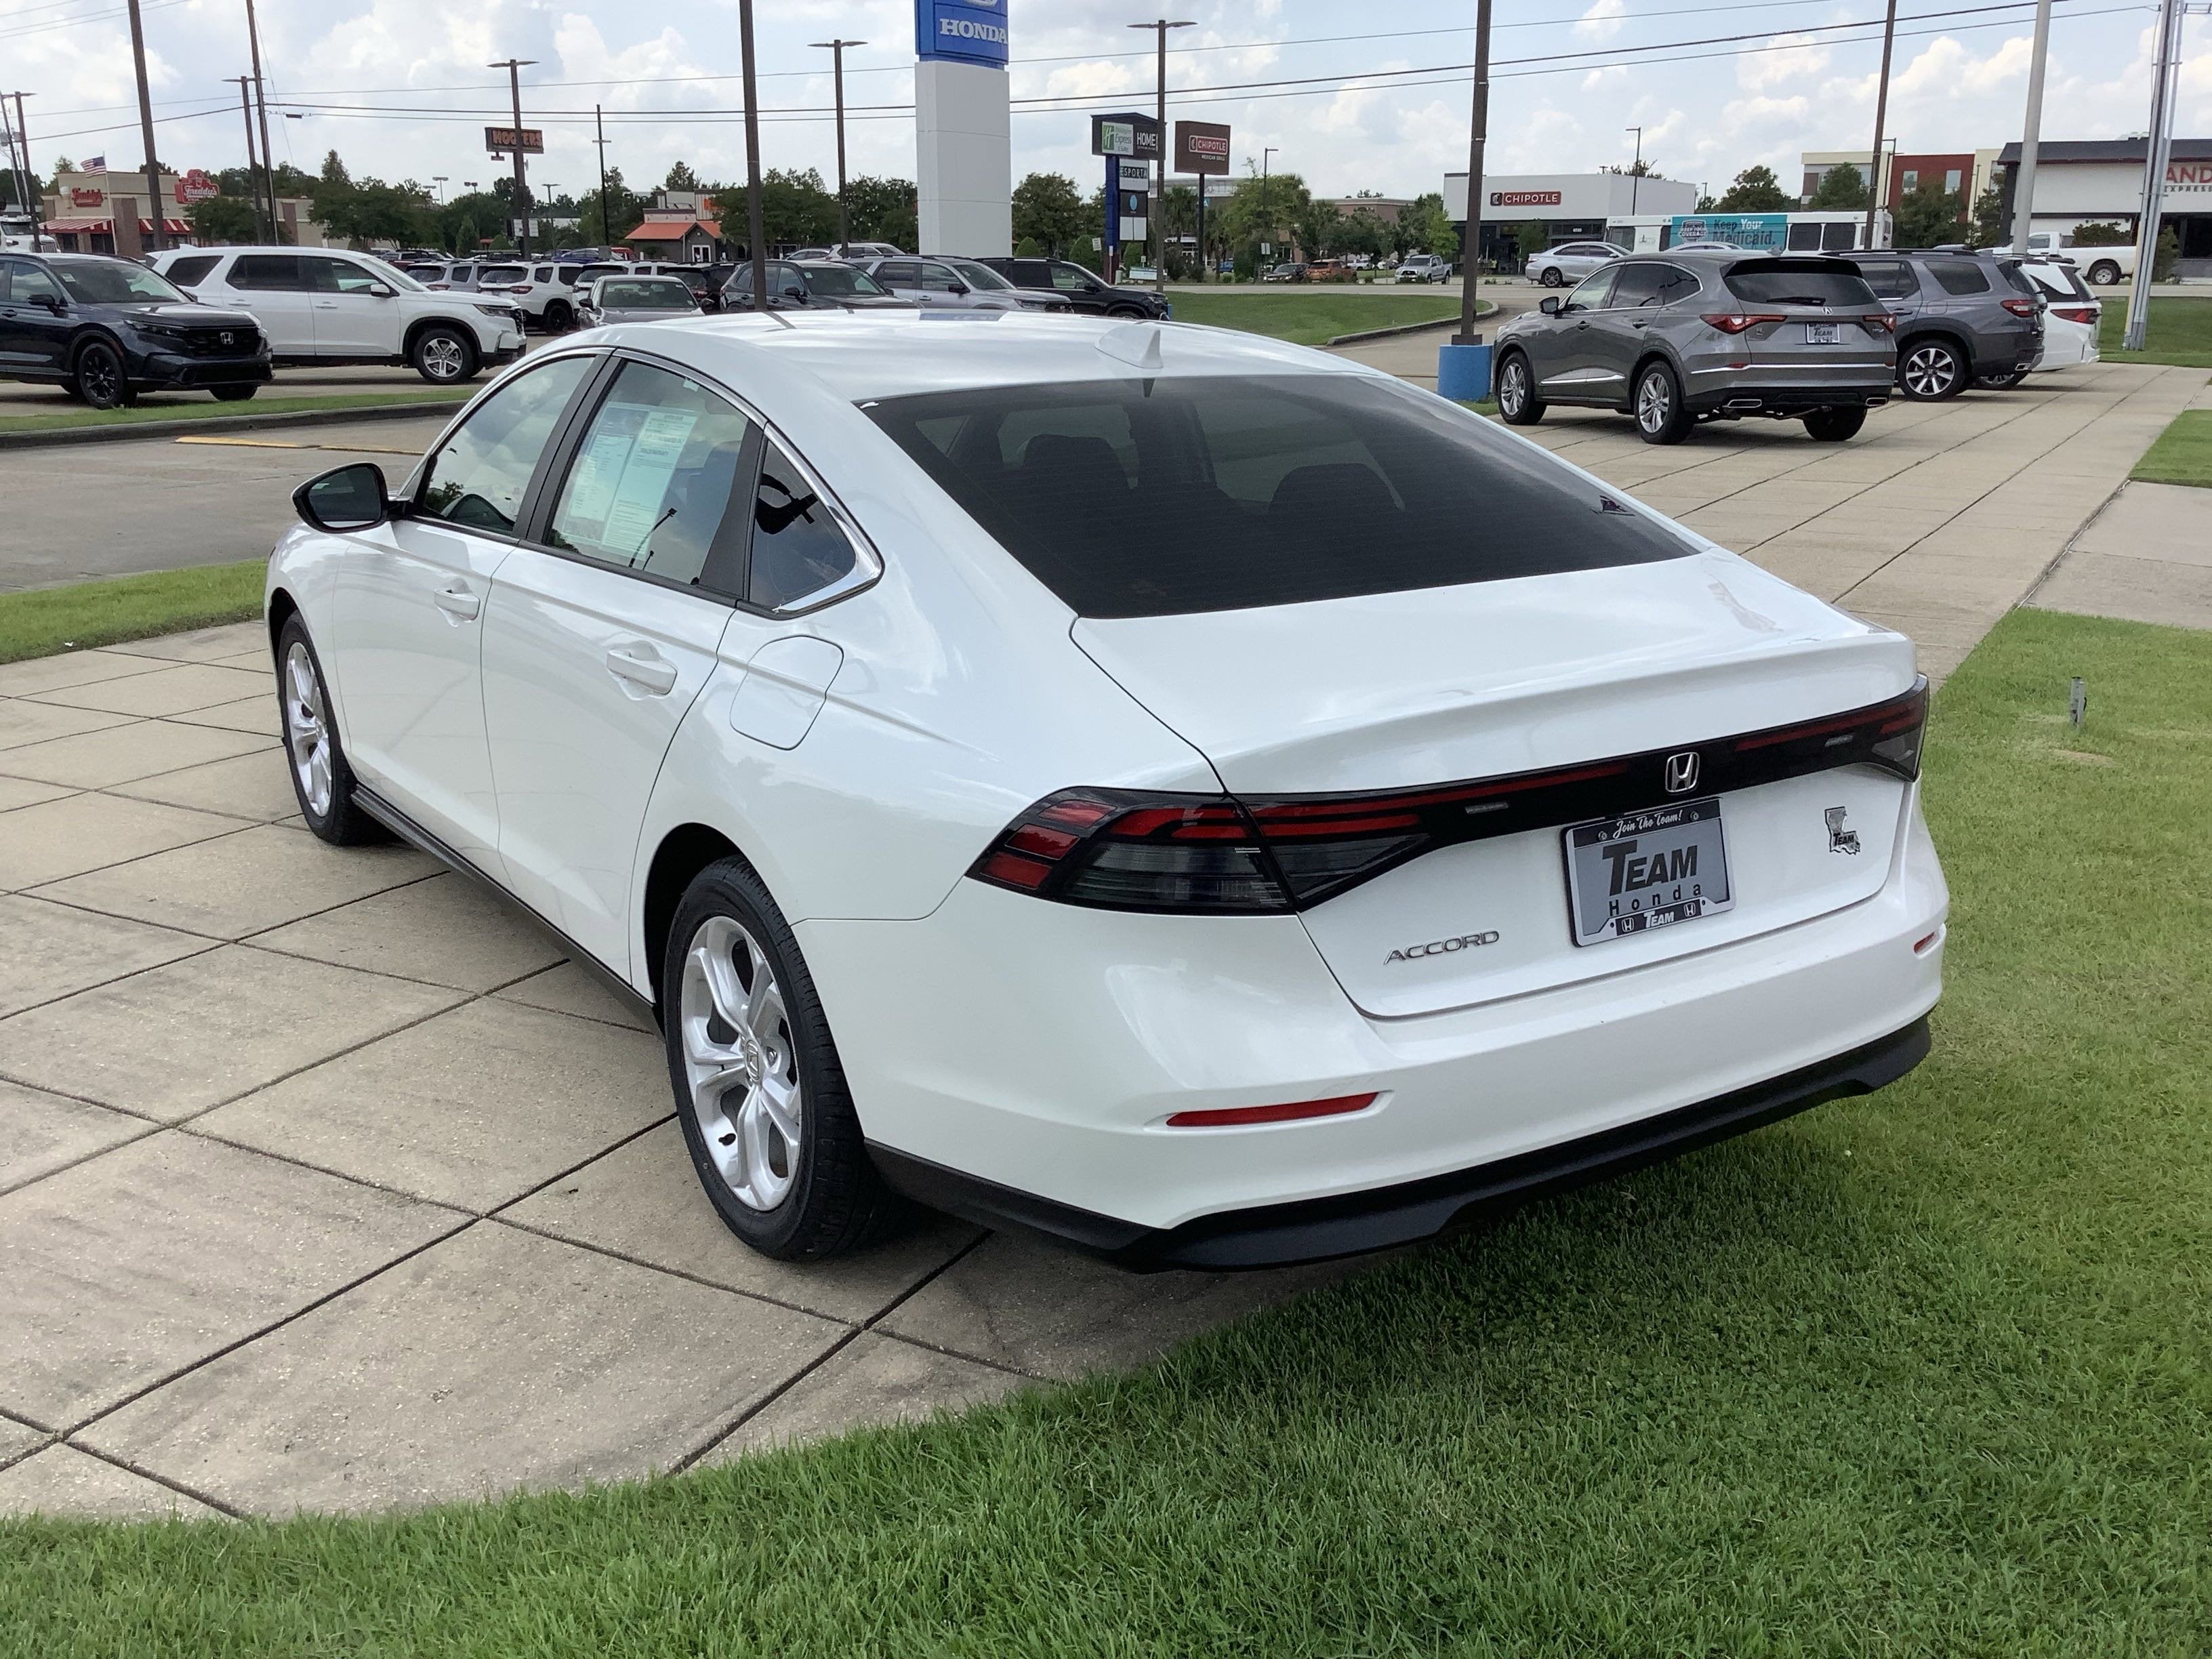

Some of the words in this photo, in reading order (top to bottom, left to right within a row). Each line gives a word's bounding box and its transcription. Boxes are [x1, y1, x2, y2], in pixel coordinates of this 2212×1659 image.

[939, 18, 1008, 45] HONDA
[492, 129, 543, 147] HOOERS
[1197, 140, 1226, 151] CHIPOTLE
[1119, 167, 1149, 179] ESPORTA
[184, 185, 218, 199] Freddy's
[1504, 194, 1559, 203] CHIPOTLE
[1714, 219, 1737, 231] Keep
[1741, 218, 1764, 230] Your
[1713, 230, 1776, 245] Medicaid.
[1814, 327, 1833, 336] TEAM
[1612, 820, 1636, 839] Join
[1636, 816, 1654, 830] The
[1654, 809, 1683, 826] Team!
[1834, 832, 1854, 846] TEAM
[1602, 839, 1698, 897] TEAM
[1643, 910, 1675, 928] TEAM
[1382, 930, 1500, 966] ACCORD
